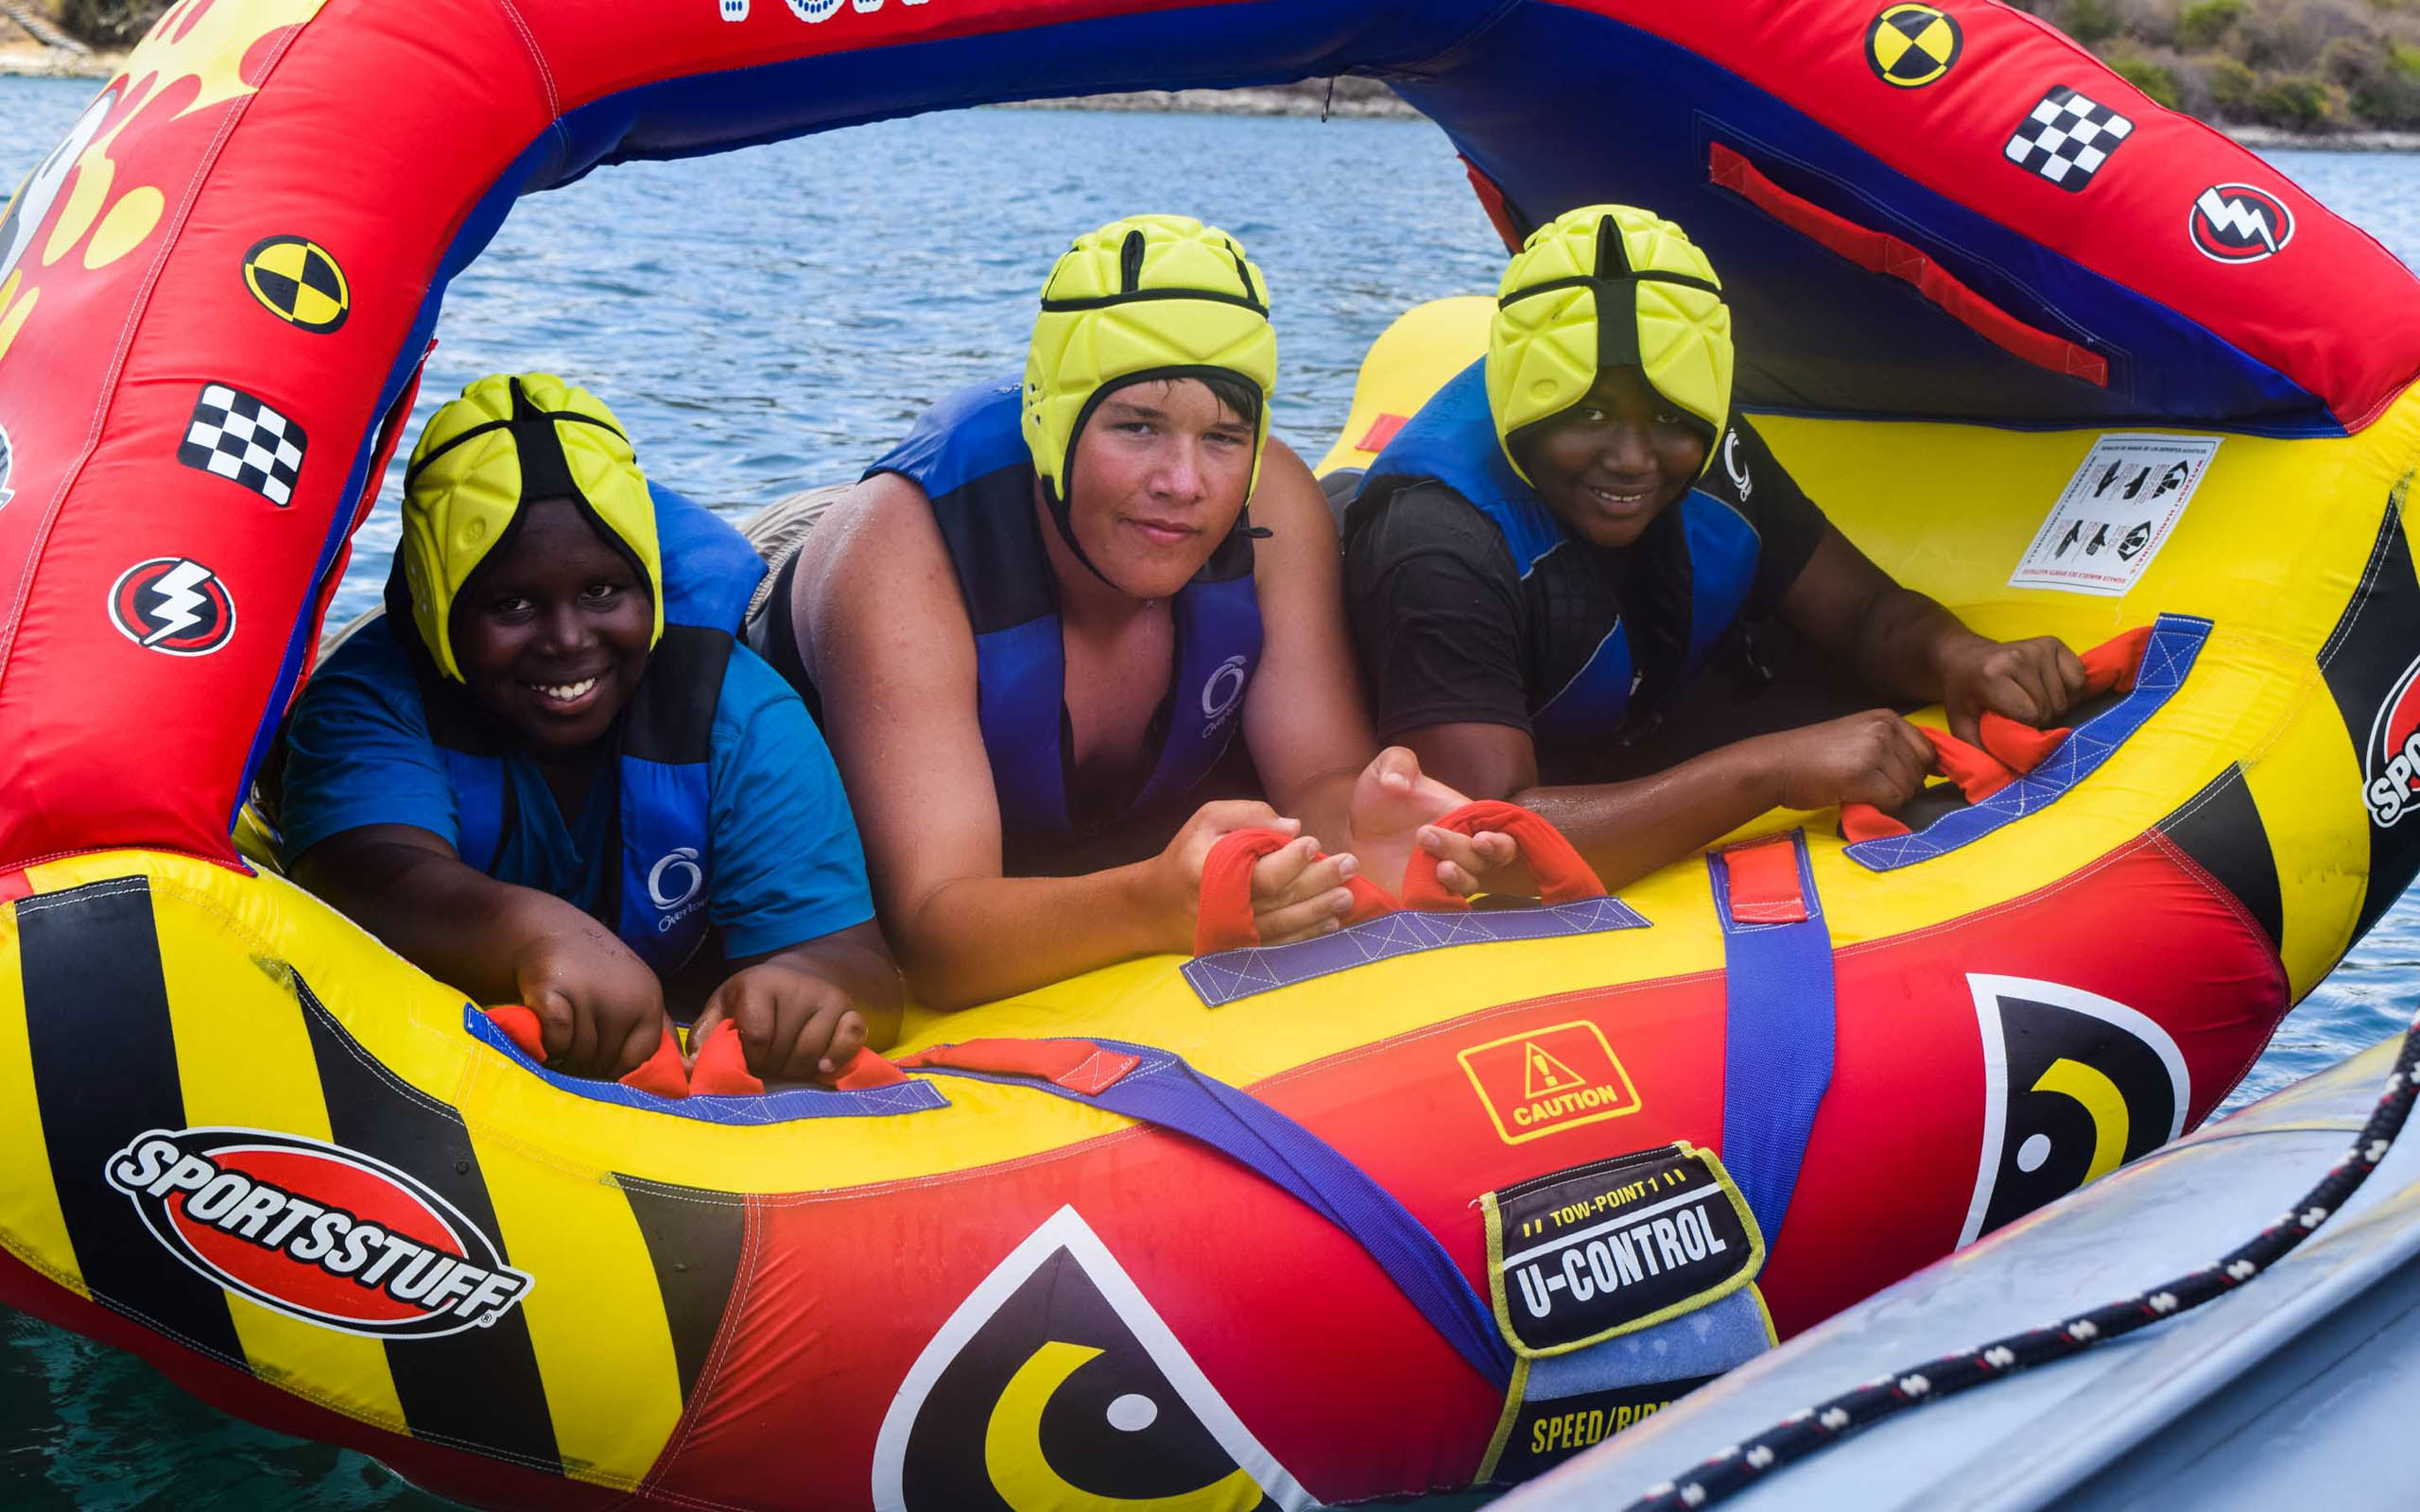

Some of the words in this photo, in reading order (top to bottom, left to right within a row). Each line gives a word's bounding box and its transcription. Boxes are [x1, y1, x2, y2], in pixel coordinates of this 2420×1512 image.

[1513, 1084, 1617, 1126] CAUTION
[1549, 1180, 1647, 1228] TOW-POINT
[1649, 1177, 1661, 1194] 1
[1514, 1203, 1727, 1319] U-CONTROL
